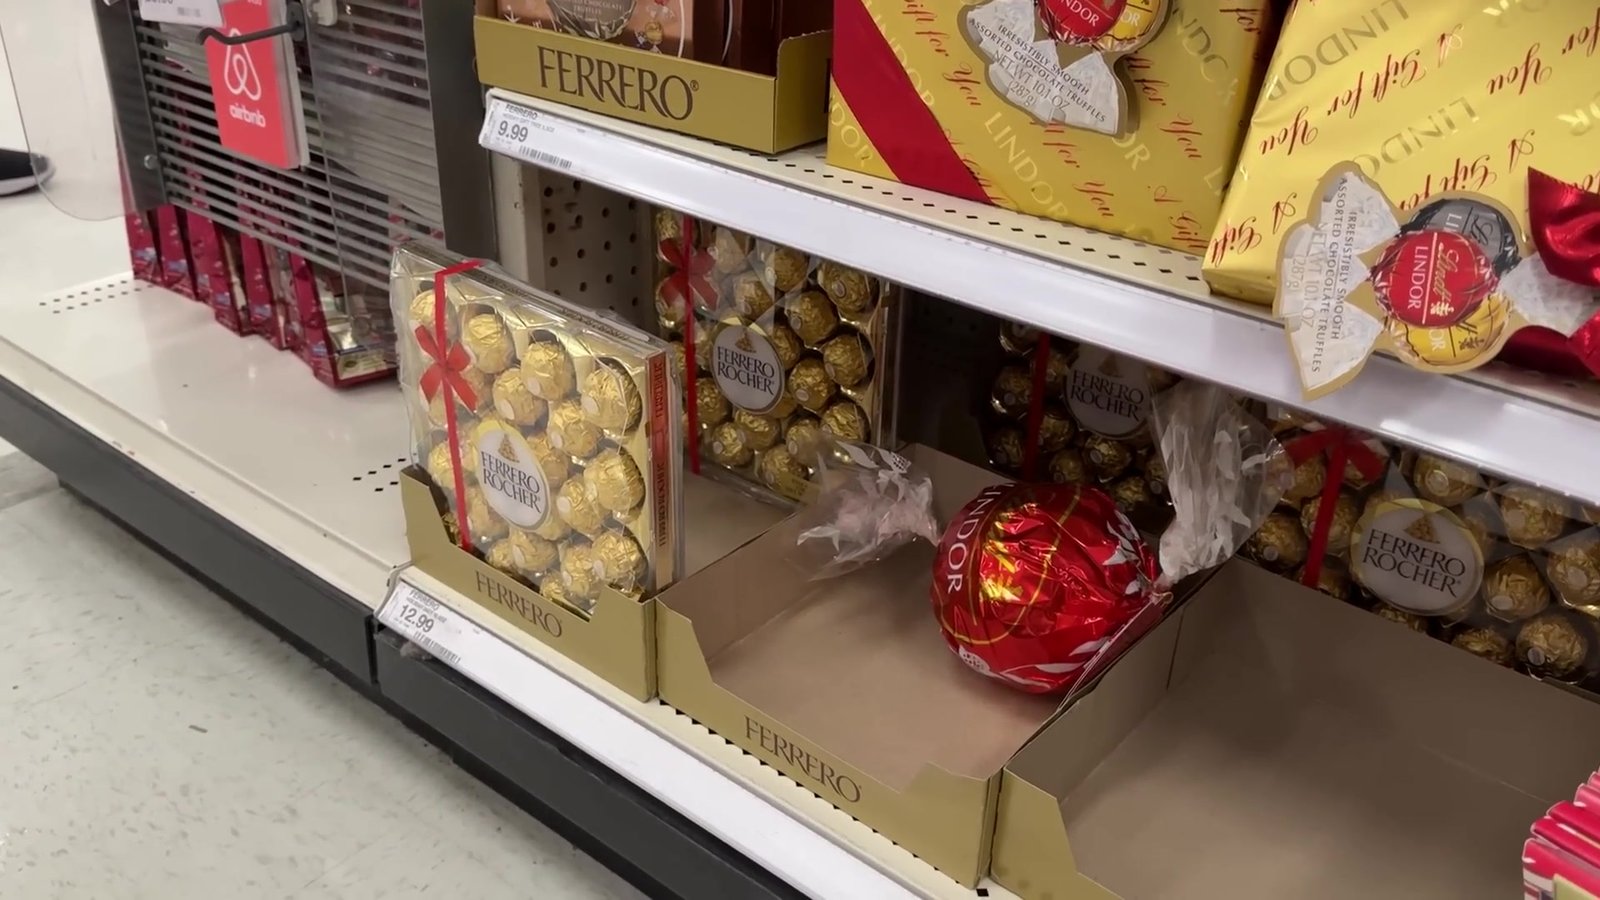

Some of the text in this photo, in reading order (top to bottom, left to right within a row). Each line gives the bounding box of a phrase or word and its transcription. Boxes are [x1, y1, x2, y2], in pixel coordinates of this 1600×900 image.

[942, 62, 982, 106] You
[969, 18, 1106, 123] ASSORTED CHOCOLATE TRUFFLES
[992, 51, 1012, 72] NET
[1012, 66, 1032, 86] WT
[1051, 95, 1071, 111] OZ
[998, 24, 1090, 96] IRRESISTIBLY SMOOTH
[1371, 49, 1427, 103] Gift
[1487, 42, 1552, 95] You
[229, 102, 267, 128] airbnb
[505, 103, 538, 120] FERRERO
[1327, 71, 1364, 119] for
[498, 120, 528, 142] 9.99
[1159, 112, 1202, 158] You
[1259, 106, 1318, 155] You
[1353, 97, 1479, 177] LINDO
[1211, 216, 1262, 268] Gift
[1311, 177, 1348, 373] ASSORTED CHOCOLATE TRUFFLES
[1330, 211, 1357, 340] IRRESISTIBLY SMOOTH
[1408, 245, 1429, 309] LINDOR
[1301, 307, 1316, 328] OZ
[717, 346, 775, 379] FERRERO
[717, 362, 775, 396] ROCHER
[1072, 369, 1144, 405] FERRERO
[1069, 384, 1140, 421] ROCHER
[481, 451, 540, 494] FERRERO
[483, 472, 541, 514] ROCHER
[1362, 547, 1457, 598] ROCHER
[1368, 528, 1466, 577] FERRERO
[400, 604, 434, 632] 12.99
[475, 570, 562, 638] FERRERO
[744, 715, 861, 803] FERRERO
